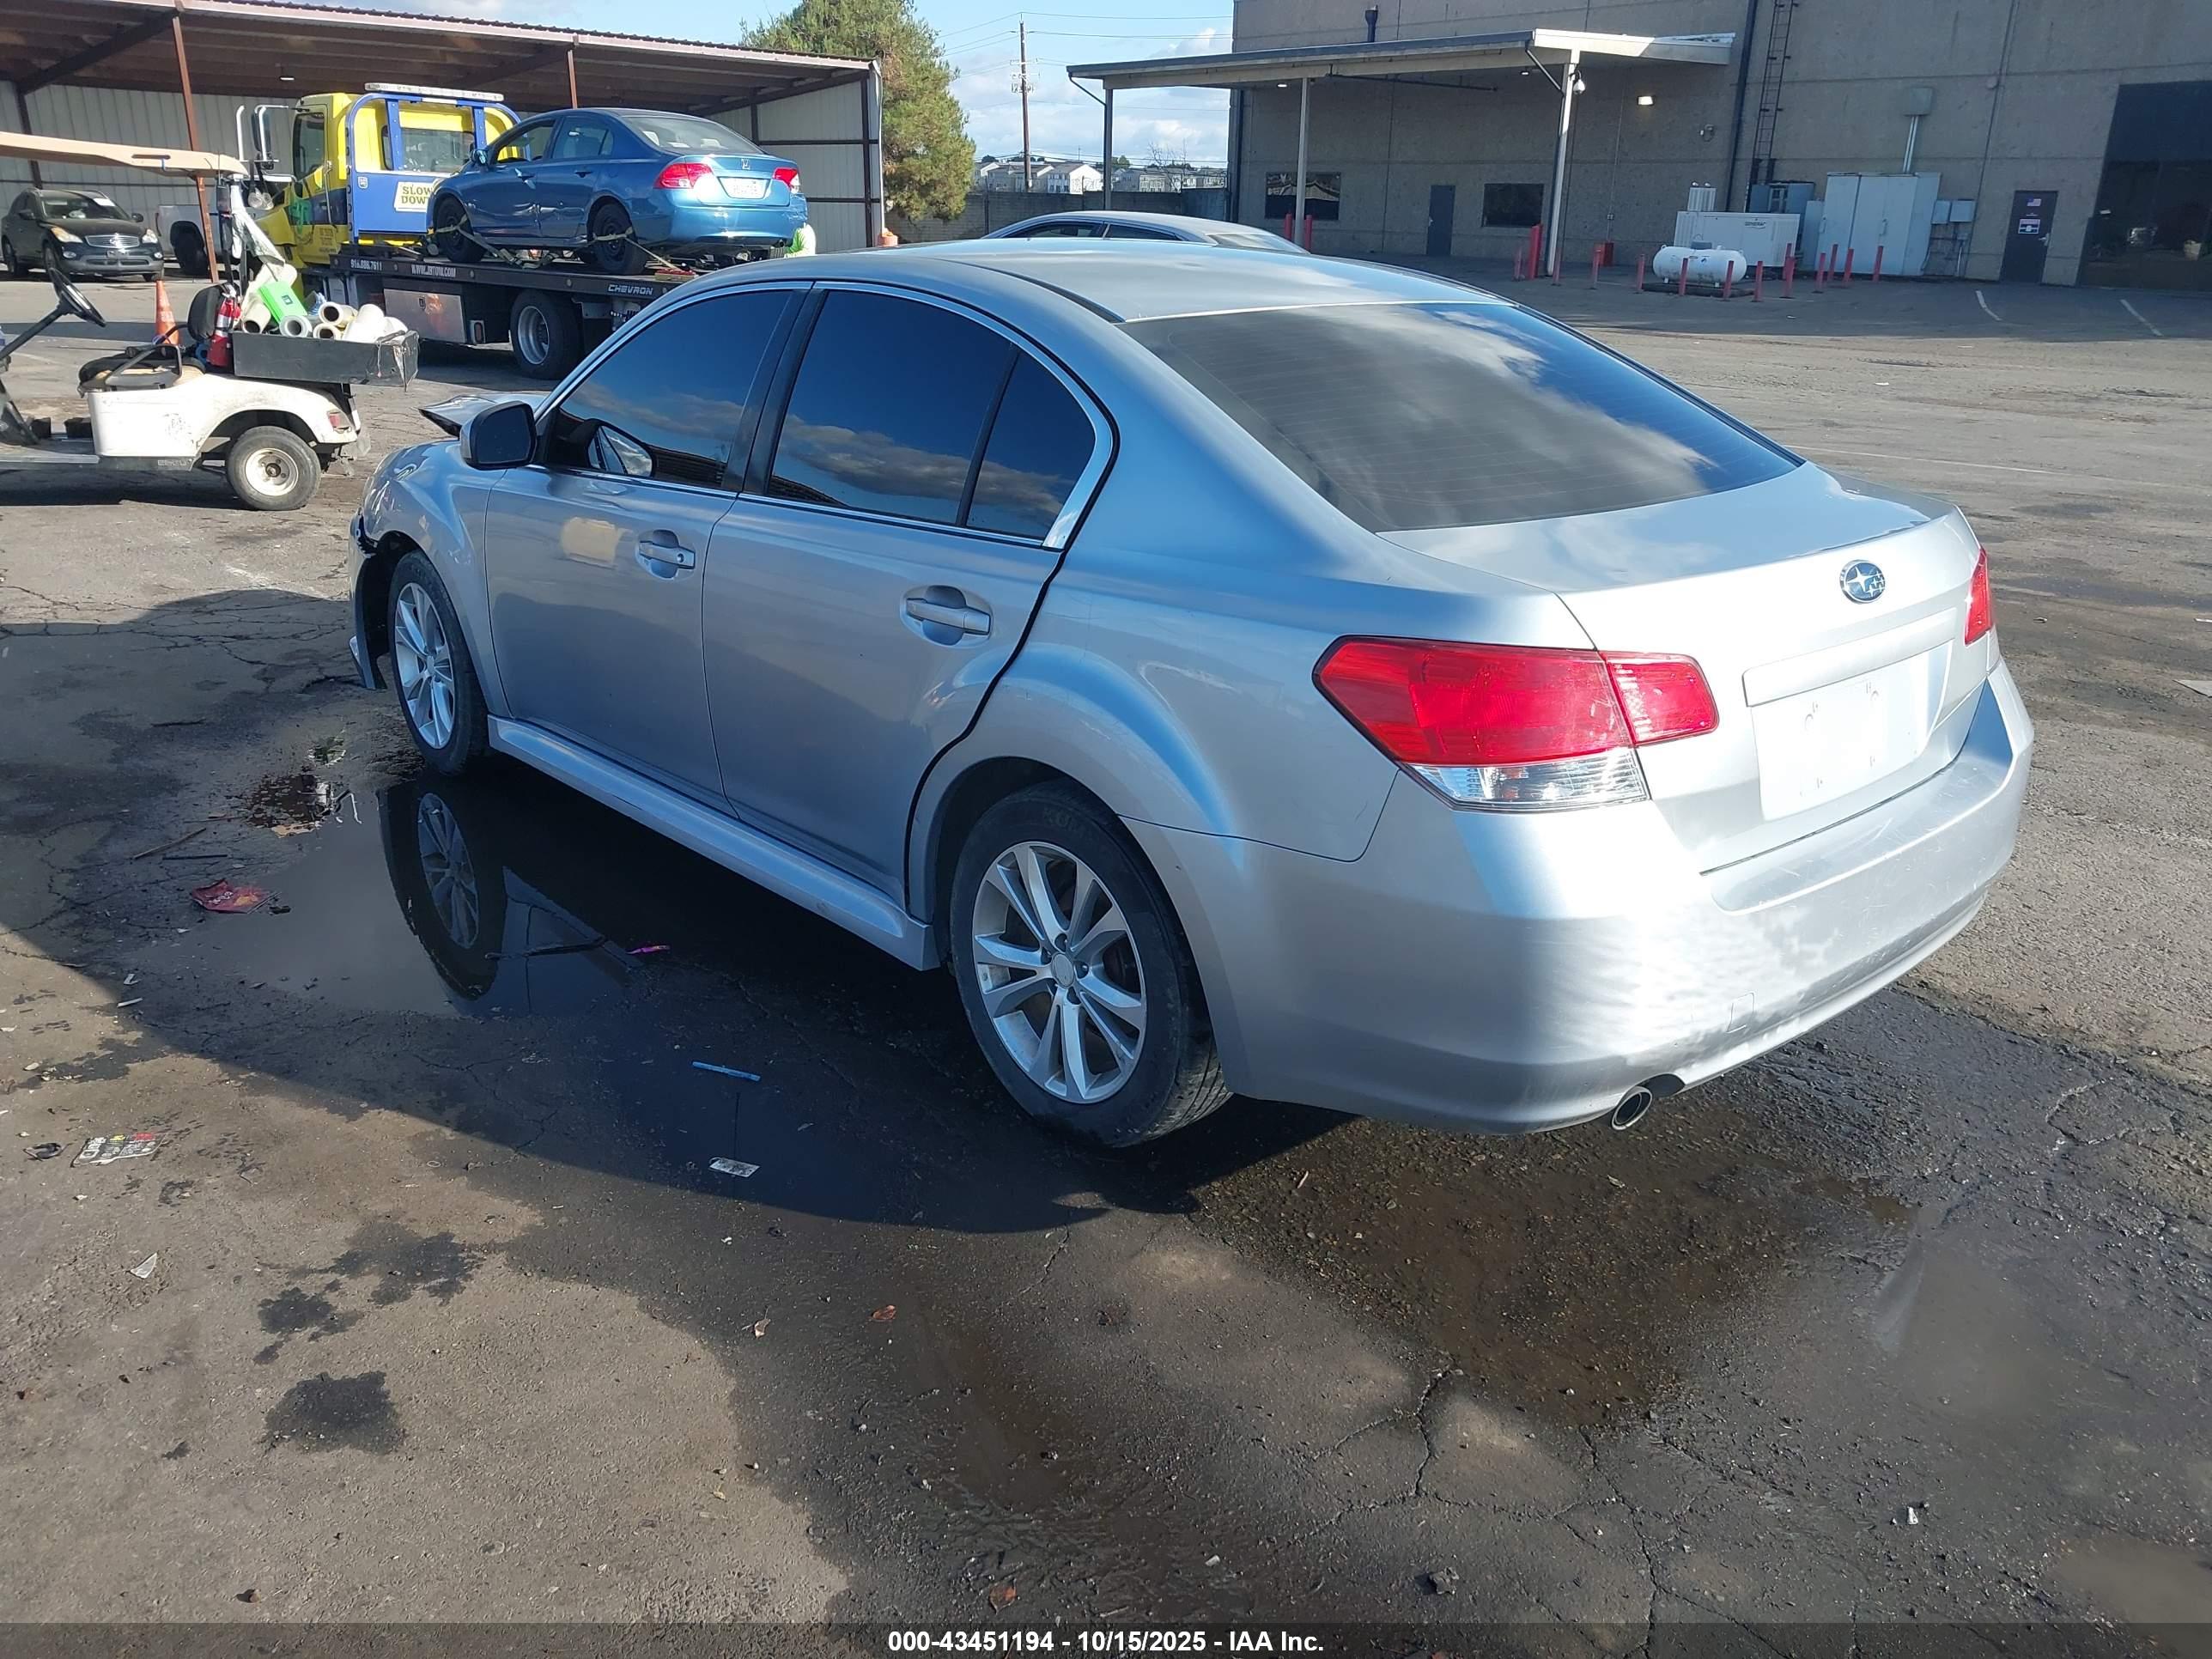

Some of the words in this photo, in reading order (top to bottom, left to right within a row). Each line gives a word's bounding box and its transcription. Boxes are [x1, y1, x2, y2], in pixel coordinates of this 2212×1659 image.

[402, 185, 432, 196] SLOW
[401, 195, 430, 204] DOW
[608, 283, 653, 295] CHEVRON
